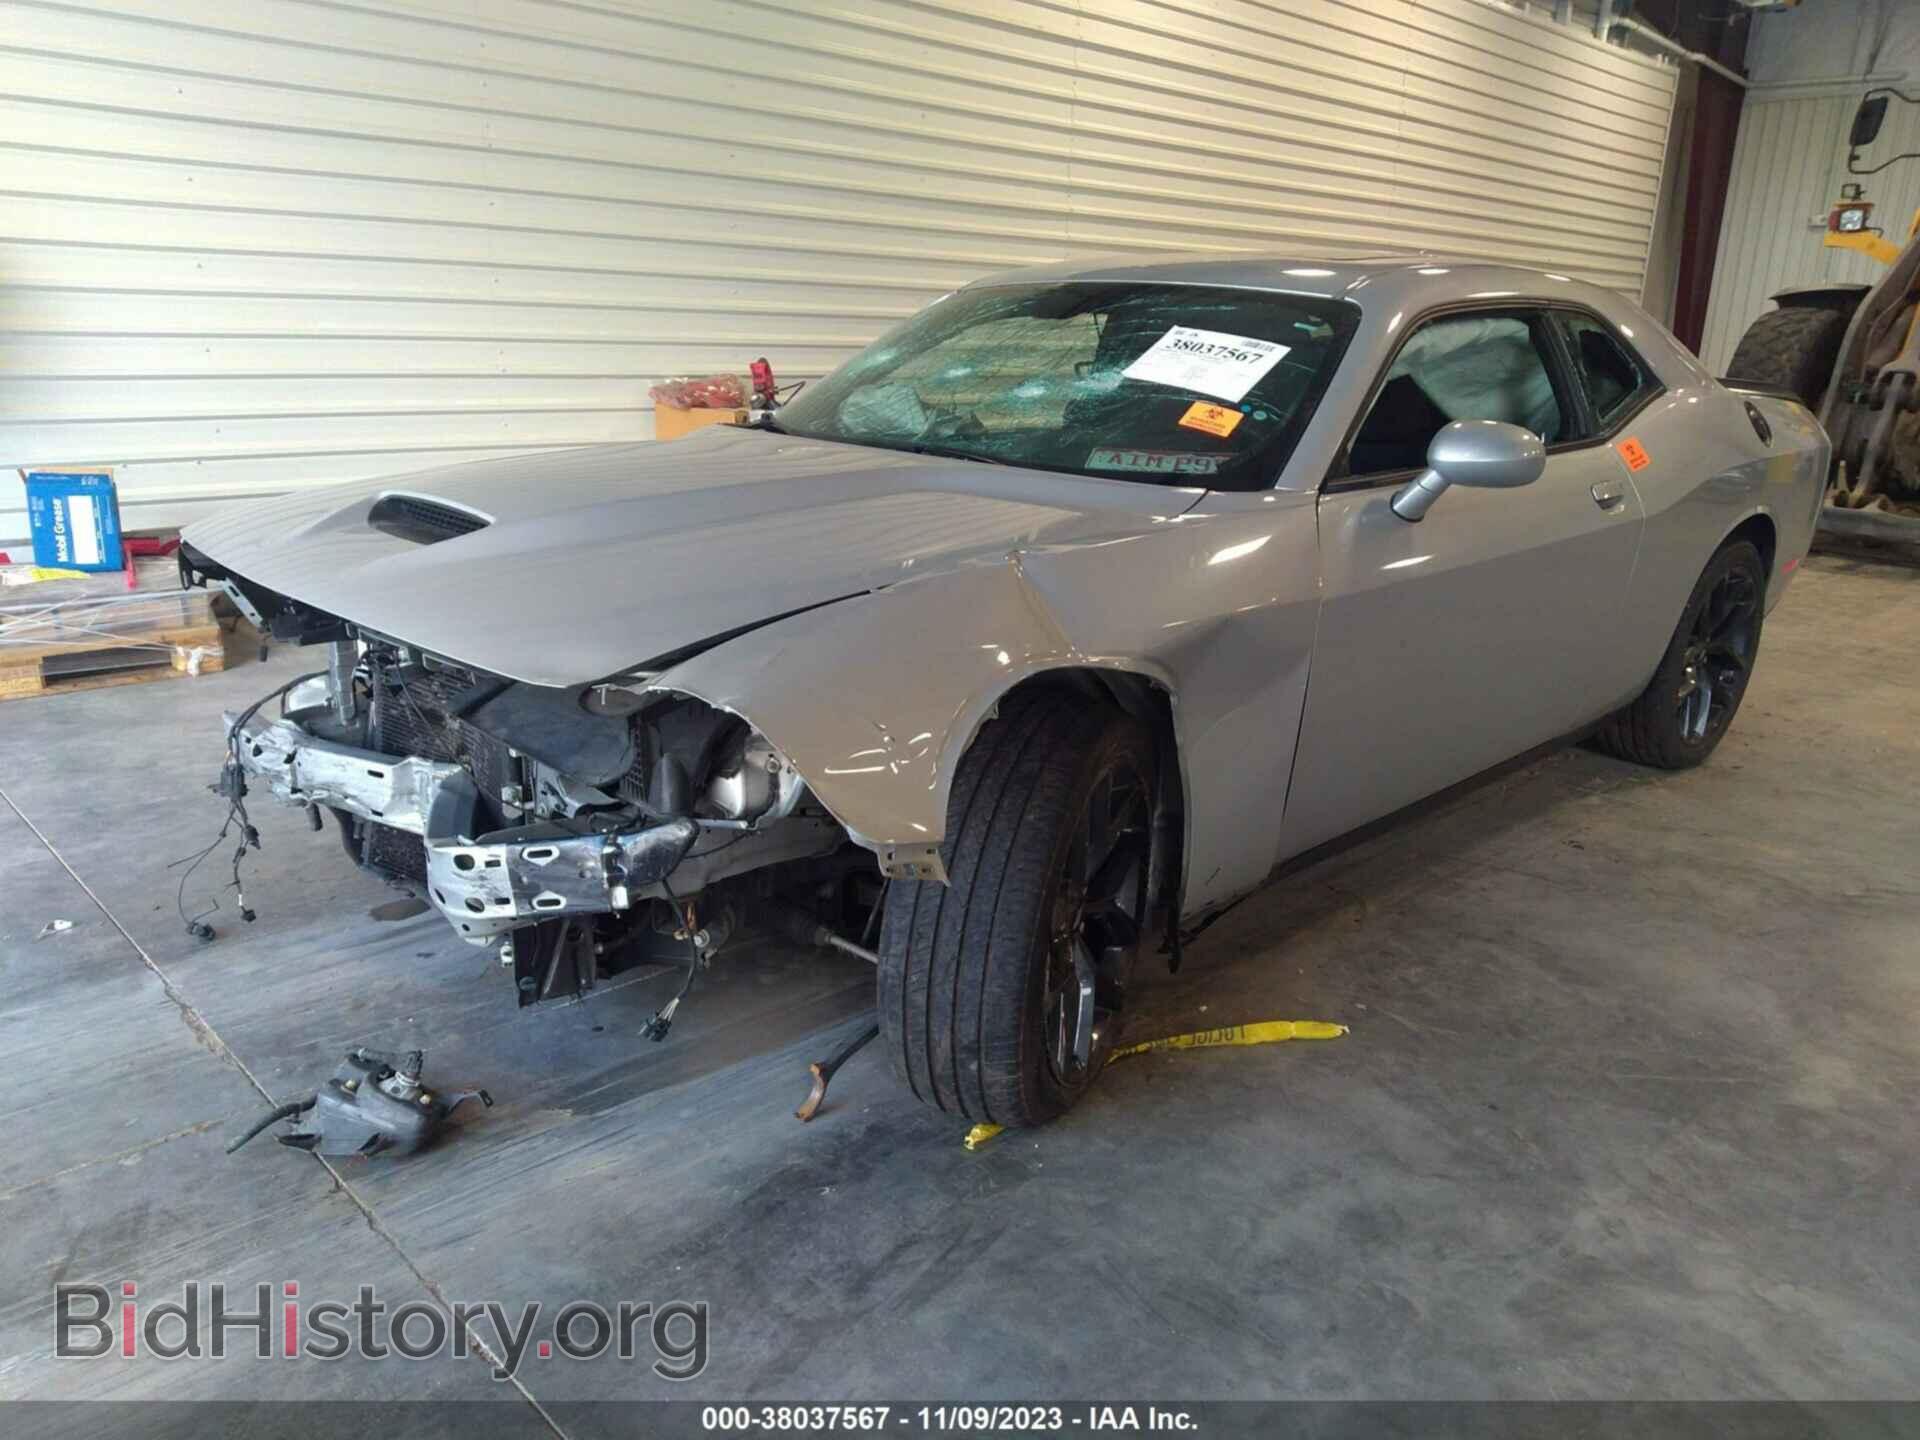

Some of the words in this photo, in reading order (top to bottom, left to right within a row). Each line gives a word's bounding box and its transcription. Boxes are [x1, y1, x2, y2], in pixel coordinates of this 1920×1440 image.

[1165, 339, 1264, 364] 38037567
[52, 497, 65, 535] Grease
[55, 535, 69, 562] Mobil
